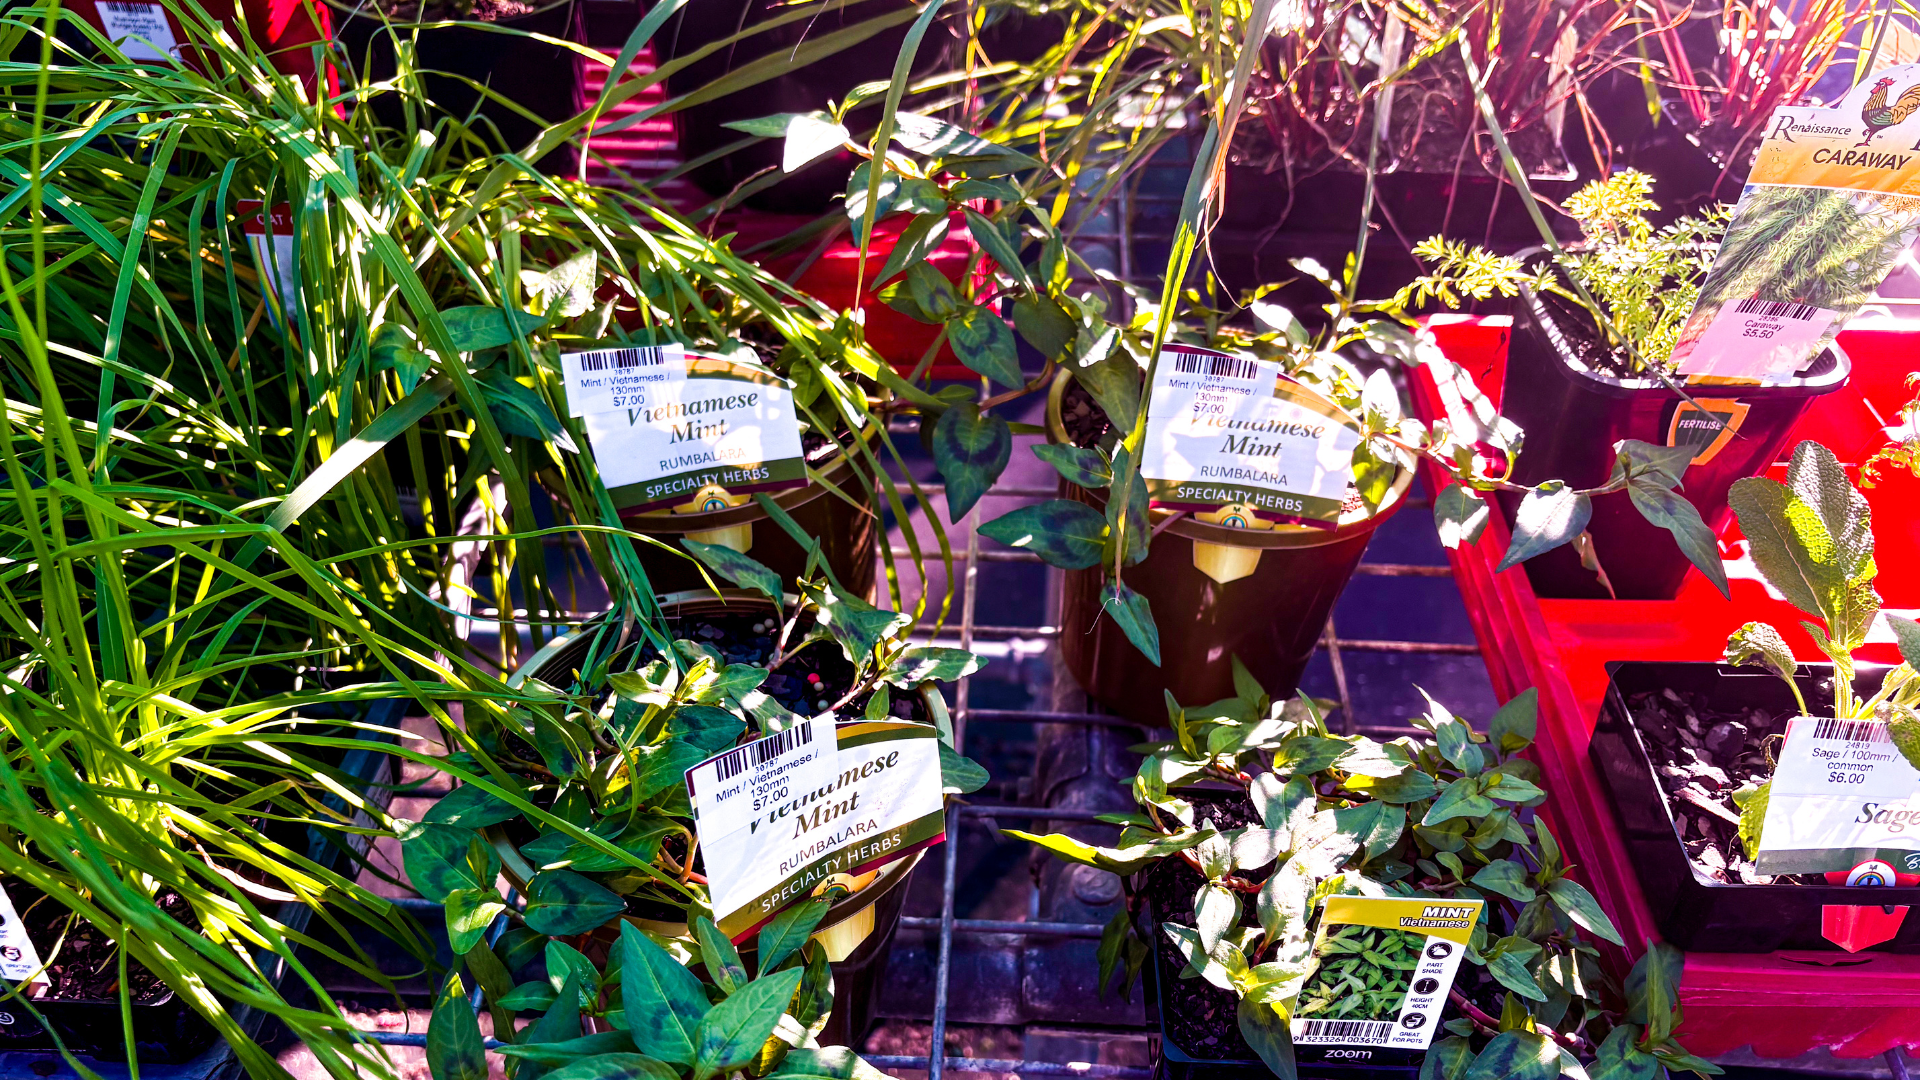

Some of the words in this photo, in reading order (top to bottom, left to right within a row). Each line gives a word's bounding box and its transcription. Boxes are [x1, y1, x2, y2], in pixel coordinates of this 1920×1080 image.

[1767, 115, 1851, 143] Renaissance
[1812, 148, 1912, 170] CARAWAY
[1742, 328, 1774, 339] $5.50
[1744, 320, 1785, 332] Caraway
[580, 378, 602, 388] Mint
[609, 374, 665, 385] Vietnamese
[1169, 379, 1189, 389] Mint
[1197, 381, 1251, 396] Vietnamese
[610, 386, 645, 396] 130mm
[1195, 392, 1228, 403] 130mm
[613, 395, 645, 407] $7.00
[627, 392, 759, 427] Vietnamese
[1193, 402, 1225, 414] $7.00
[669, 419, 728, 445] Mint
[1678, 419, 1722, 431] FERTILISE
[1219, 434, 1283, 458] Mint
[659, 447, 747, 472] RUMBALARA
[646, 472, 719, 499] SPECIALTY
[723, 466, 770, 484] HERBS
[1200, 465, 1288, 487] RUMBALARA
[1176, 486, 1251, 505] SPECIALTY
[1255, 493, 1303, 512] HERBS
[1845, 741, 1870, 750] 24819
[1812, 747, 1840, 760] Sage
[1852, 750, 1891, 763] 100mm
[755, 757, 778, 774] 30787
[1827, 762, 1874, 772] common
[716, 784, 740, 803] Mint
[749, 754, 812, 787] Vietnamese
[1828, 771, 1865, 784] $6.00
[750, 775, 790, 798] 130mm
[753, 786, 788, 811] $7.00
[792, 789, 860, 840] Mint
[1854, 802, 1920, 833] Sage
[779, 818, 878, 876] RUMBALARA
[761, 855, 841, 913] SPECIALTY
[847, 833, 902, 867] HERBS
[1422, 906, 1475, 919] MINT
[1399, 917, 1470, 928] Vietnamese
[1324, 1049, 1372, 1059] zoom
